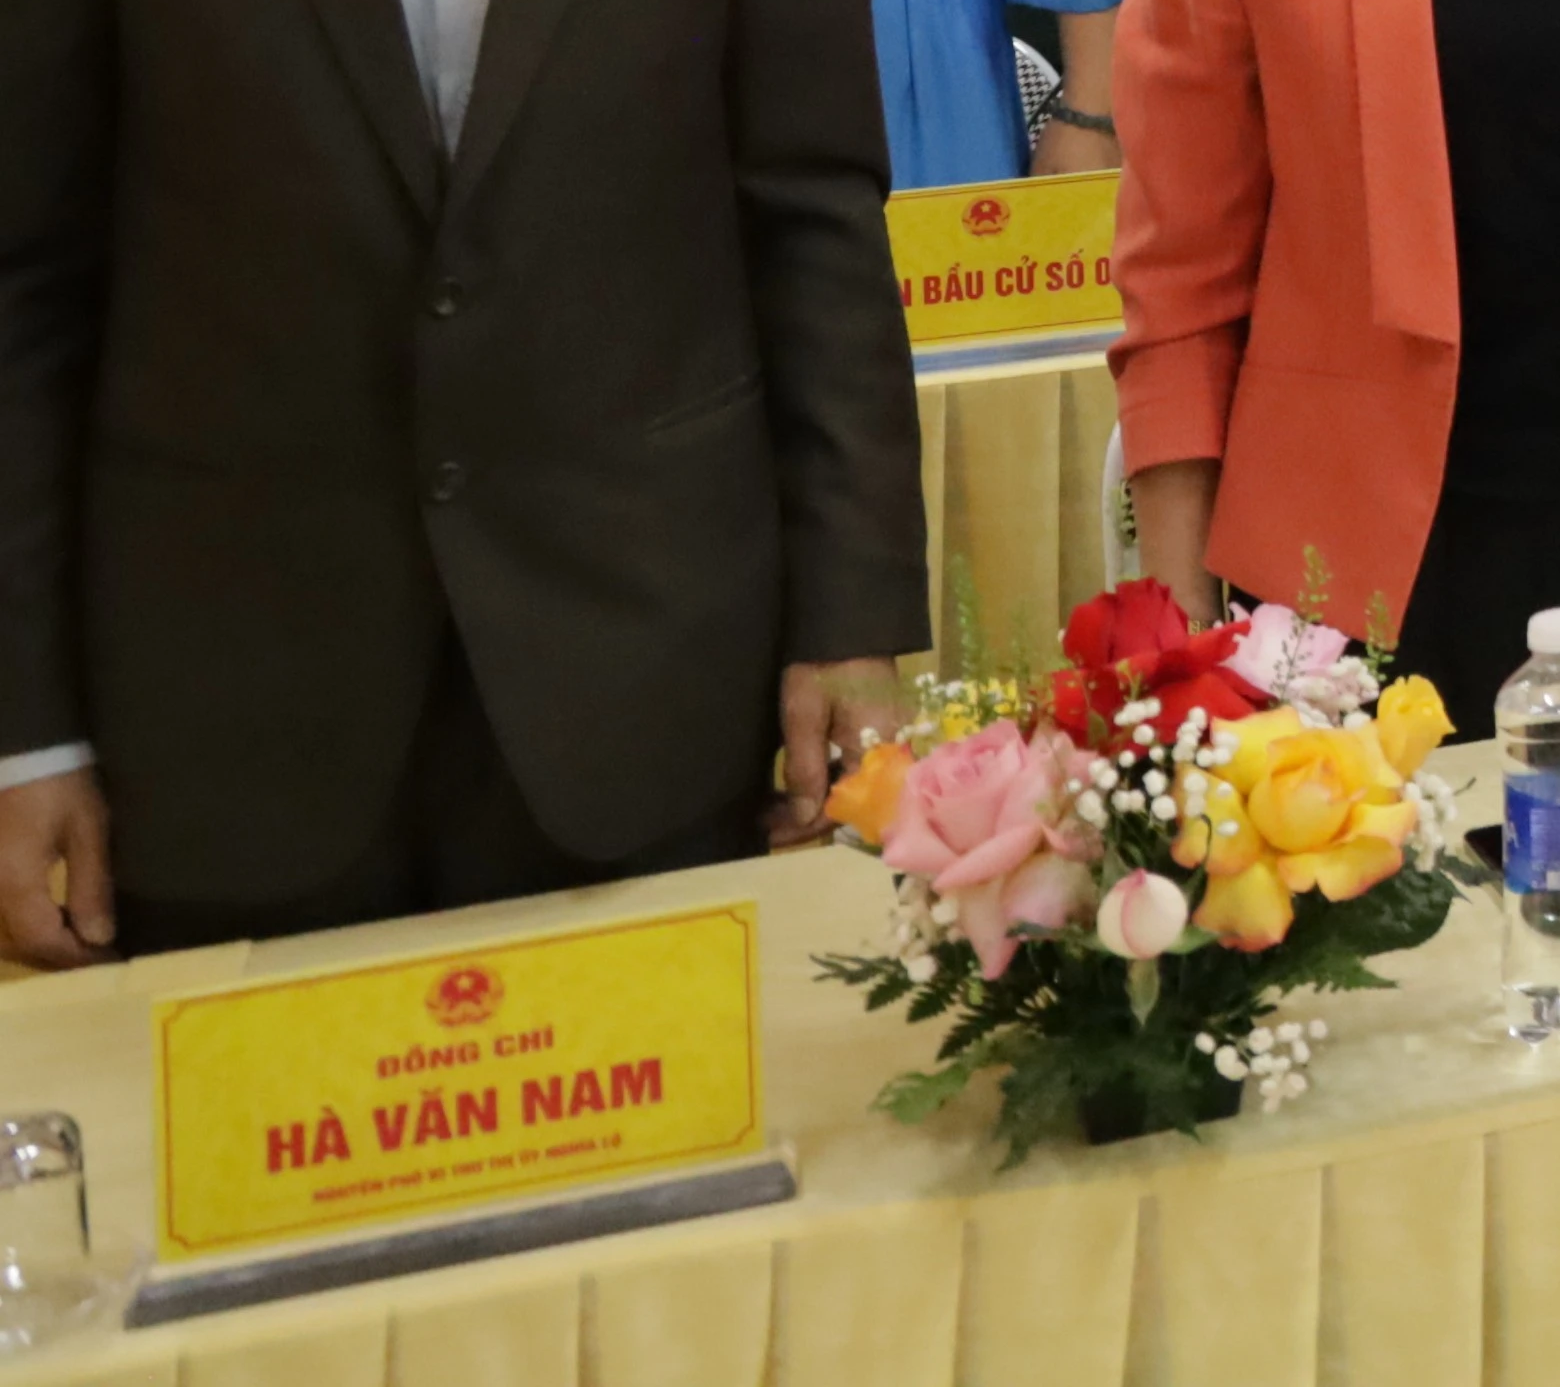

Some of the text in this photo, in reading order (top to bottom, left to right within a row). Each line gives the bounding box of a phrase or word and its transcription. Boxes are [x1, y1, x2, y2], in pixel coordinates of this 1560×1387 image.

[923, 262, 984, 305] BẦU
[995, 255, 1038, 296] CỬ
[1045, 249, 1085, 291] SỐ
[1095, 257, 1111, 286] 0
[376, 1023, 554, 1079] ĐỒNG CHÍ
[265, 1057, 664, 1174] HÀ VĂN NAM
